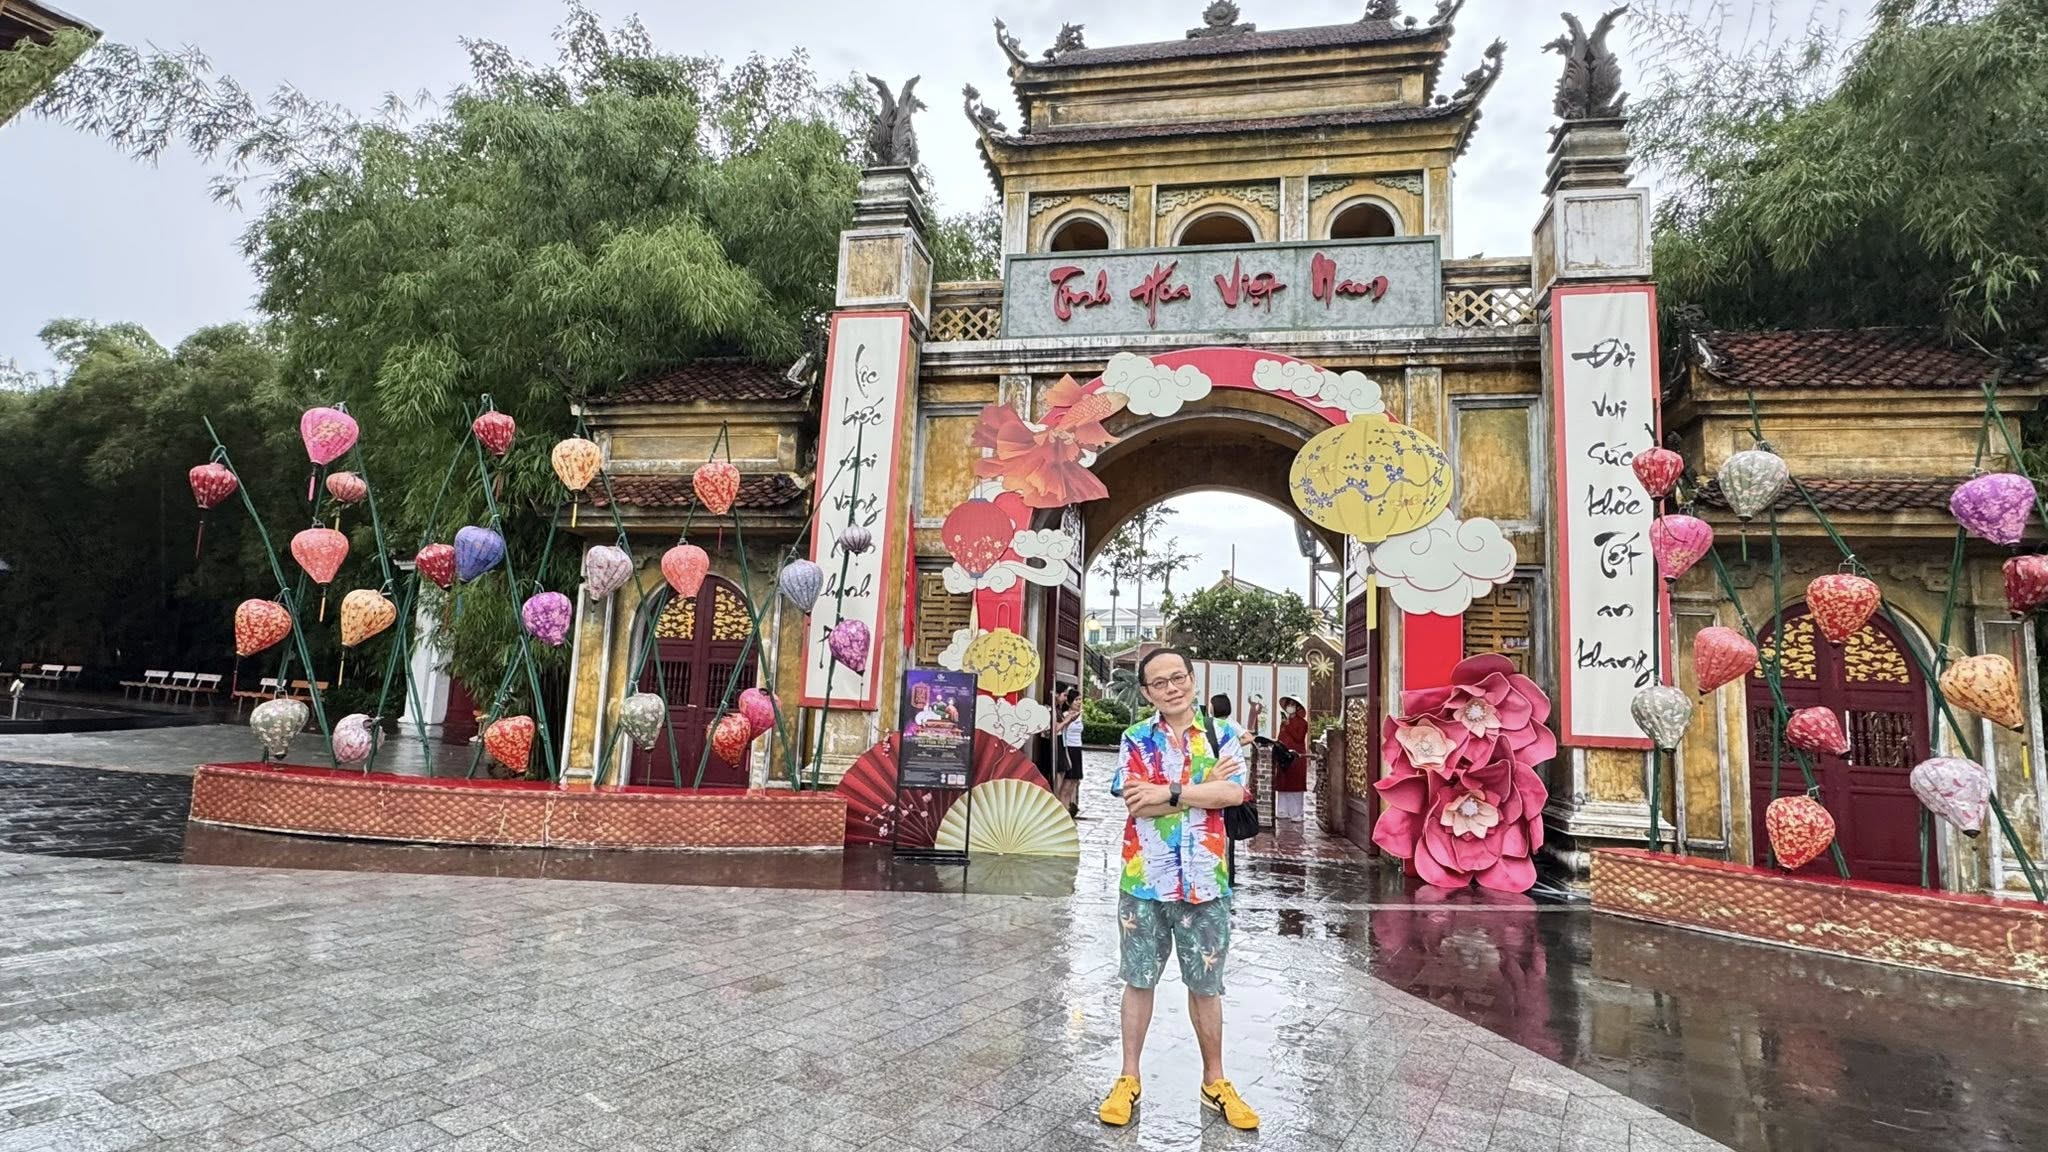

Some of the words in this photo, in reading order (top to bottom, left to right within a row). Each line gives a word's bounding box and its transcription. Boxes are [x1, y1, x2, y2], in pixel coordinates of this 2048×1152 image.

[1129, 260, 1191, 329] Hoa
[1214, 255, 1287, 313] Việt
[1311, 252, 1389, 309] Nam
[1594, 531, 1645, 579] Tết
[1597, 603, 1634, 618] an
